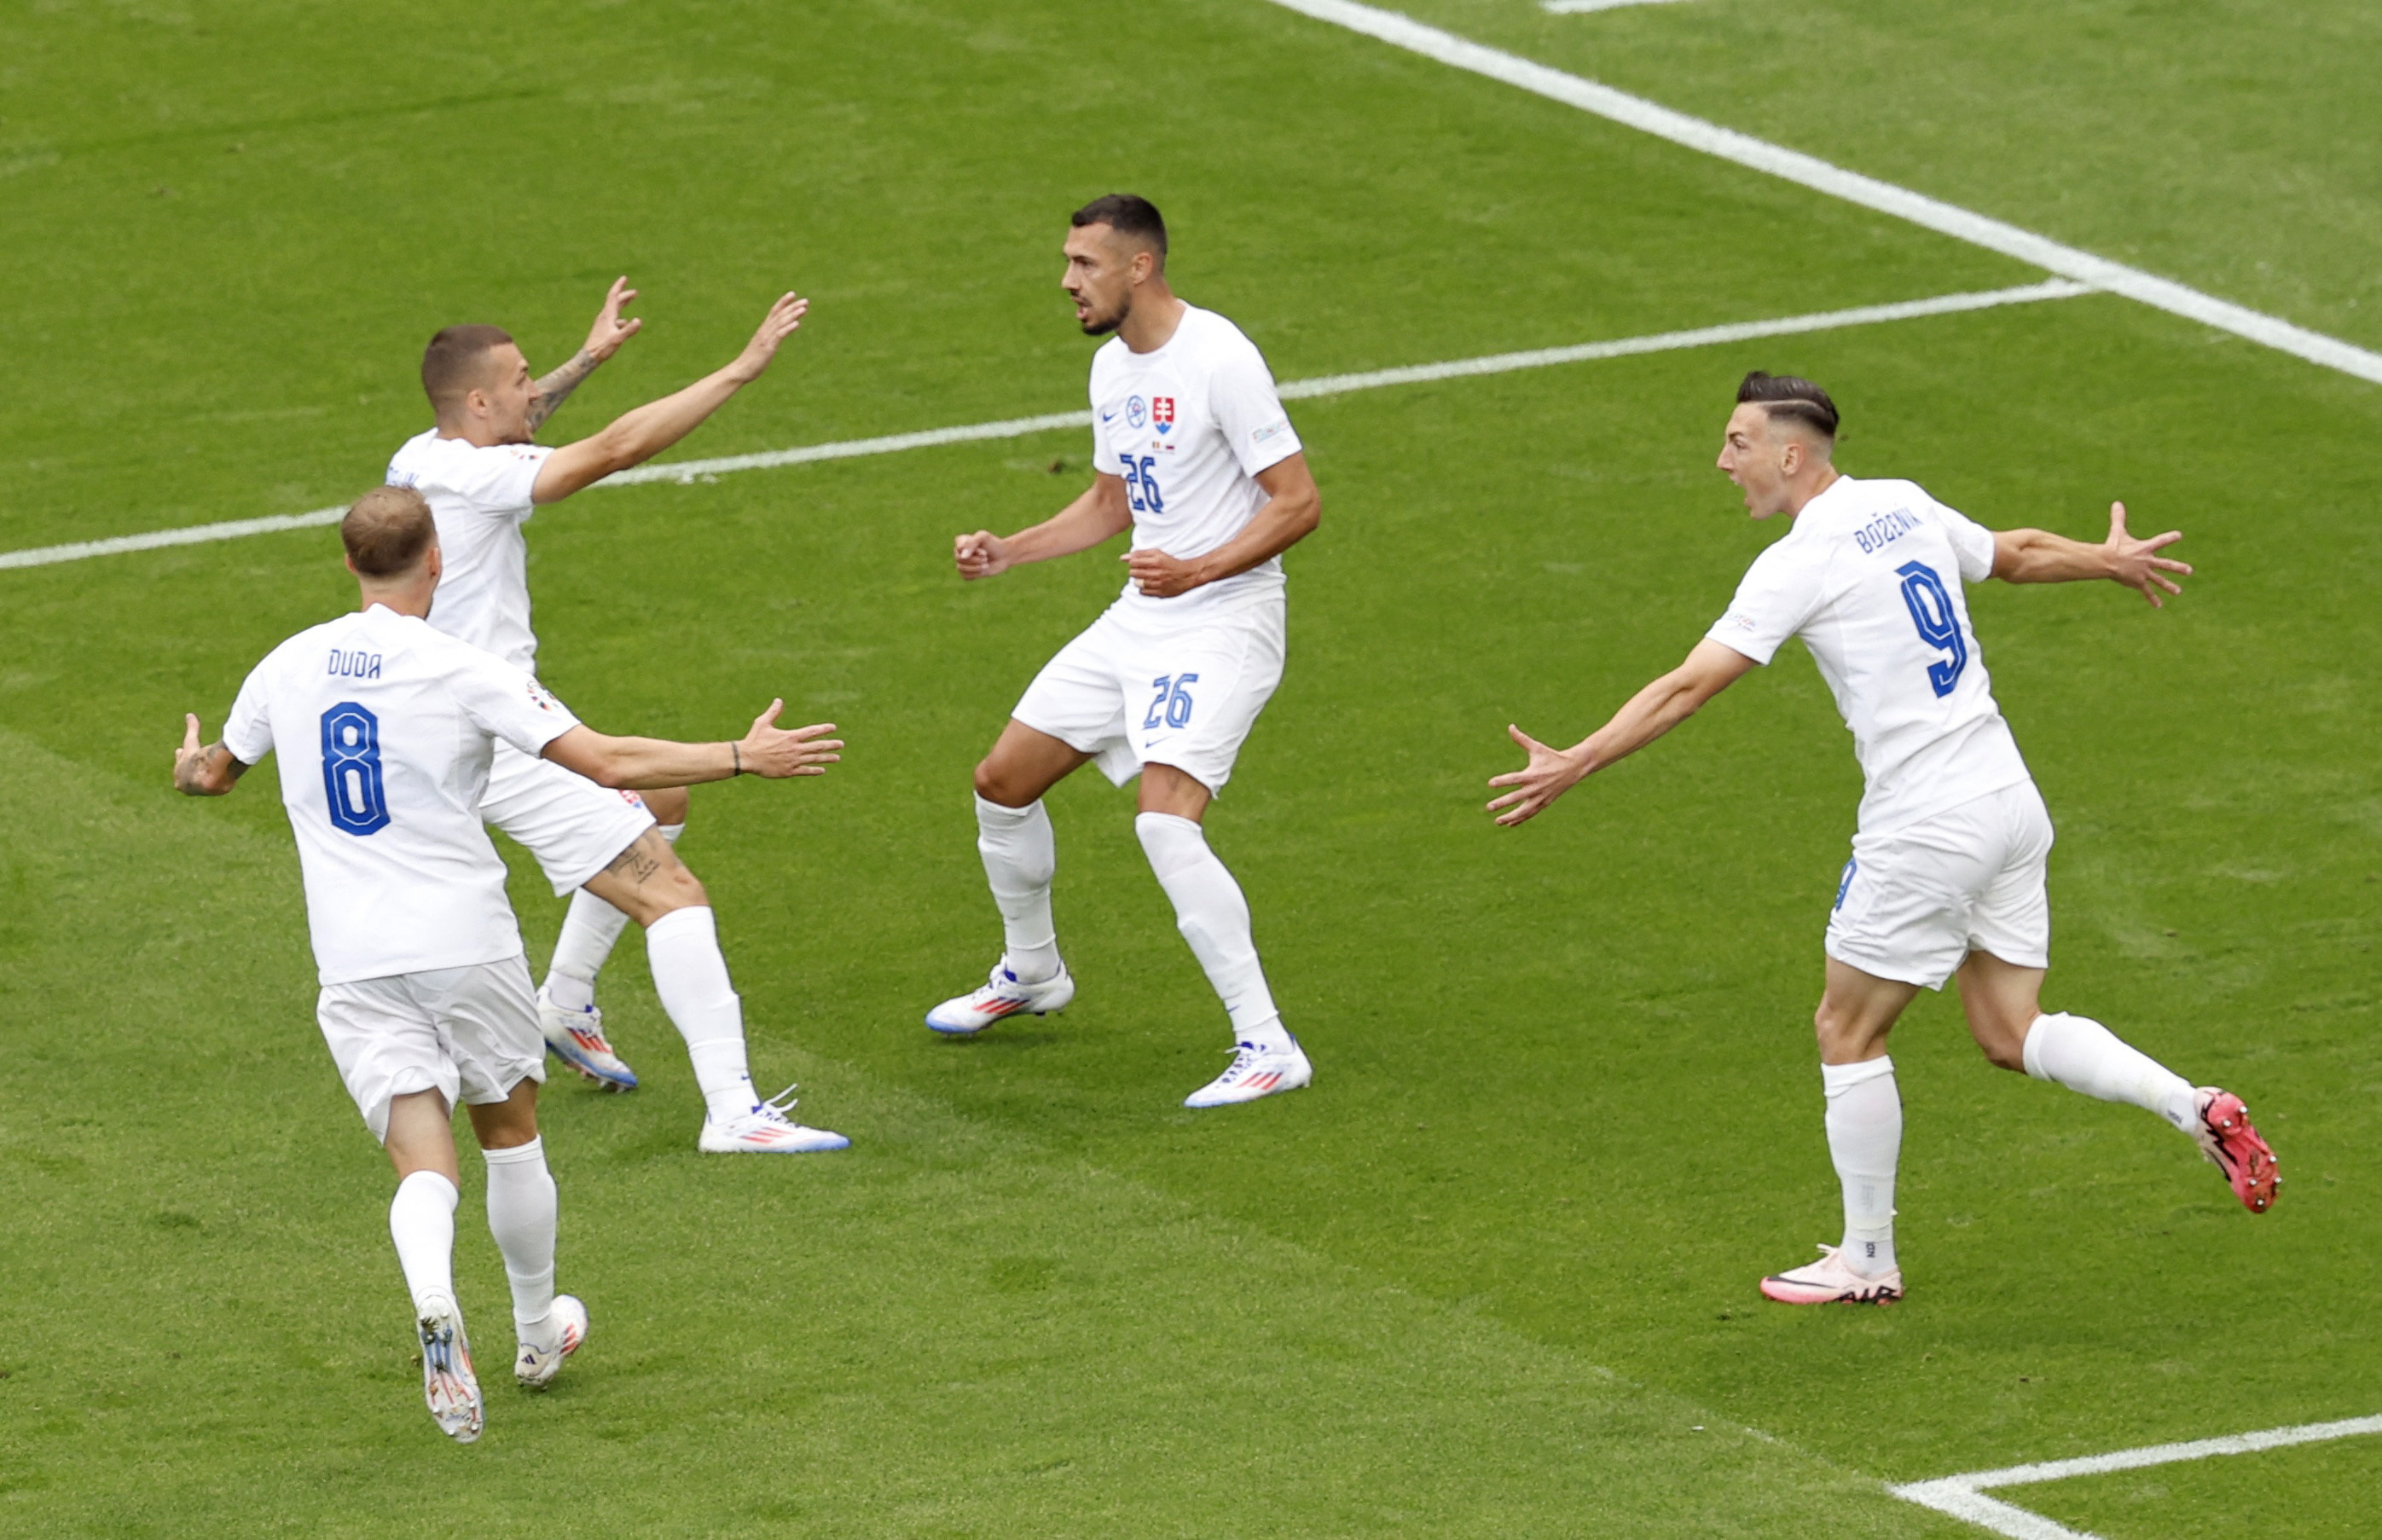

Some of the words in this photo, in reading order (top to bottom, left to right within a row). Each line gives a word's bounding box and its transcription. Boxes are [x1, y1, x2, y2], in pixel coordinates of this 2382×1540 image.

[1119, 454, 1163, 513] 26
[1894, 559, 1968, 698] 9
[328, 649, 382, 679] DUDA
[1142, 673, 1199, 730] 26
[321, 702, 391, 837] 8
